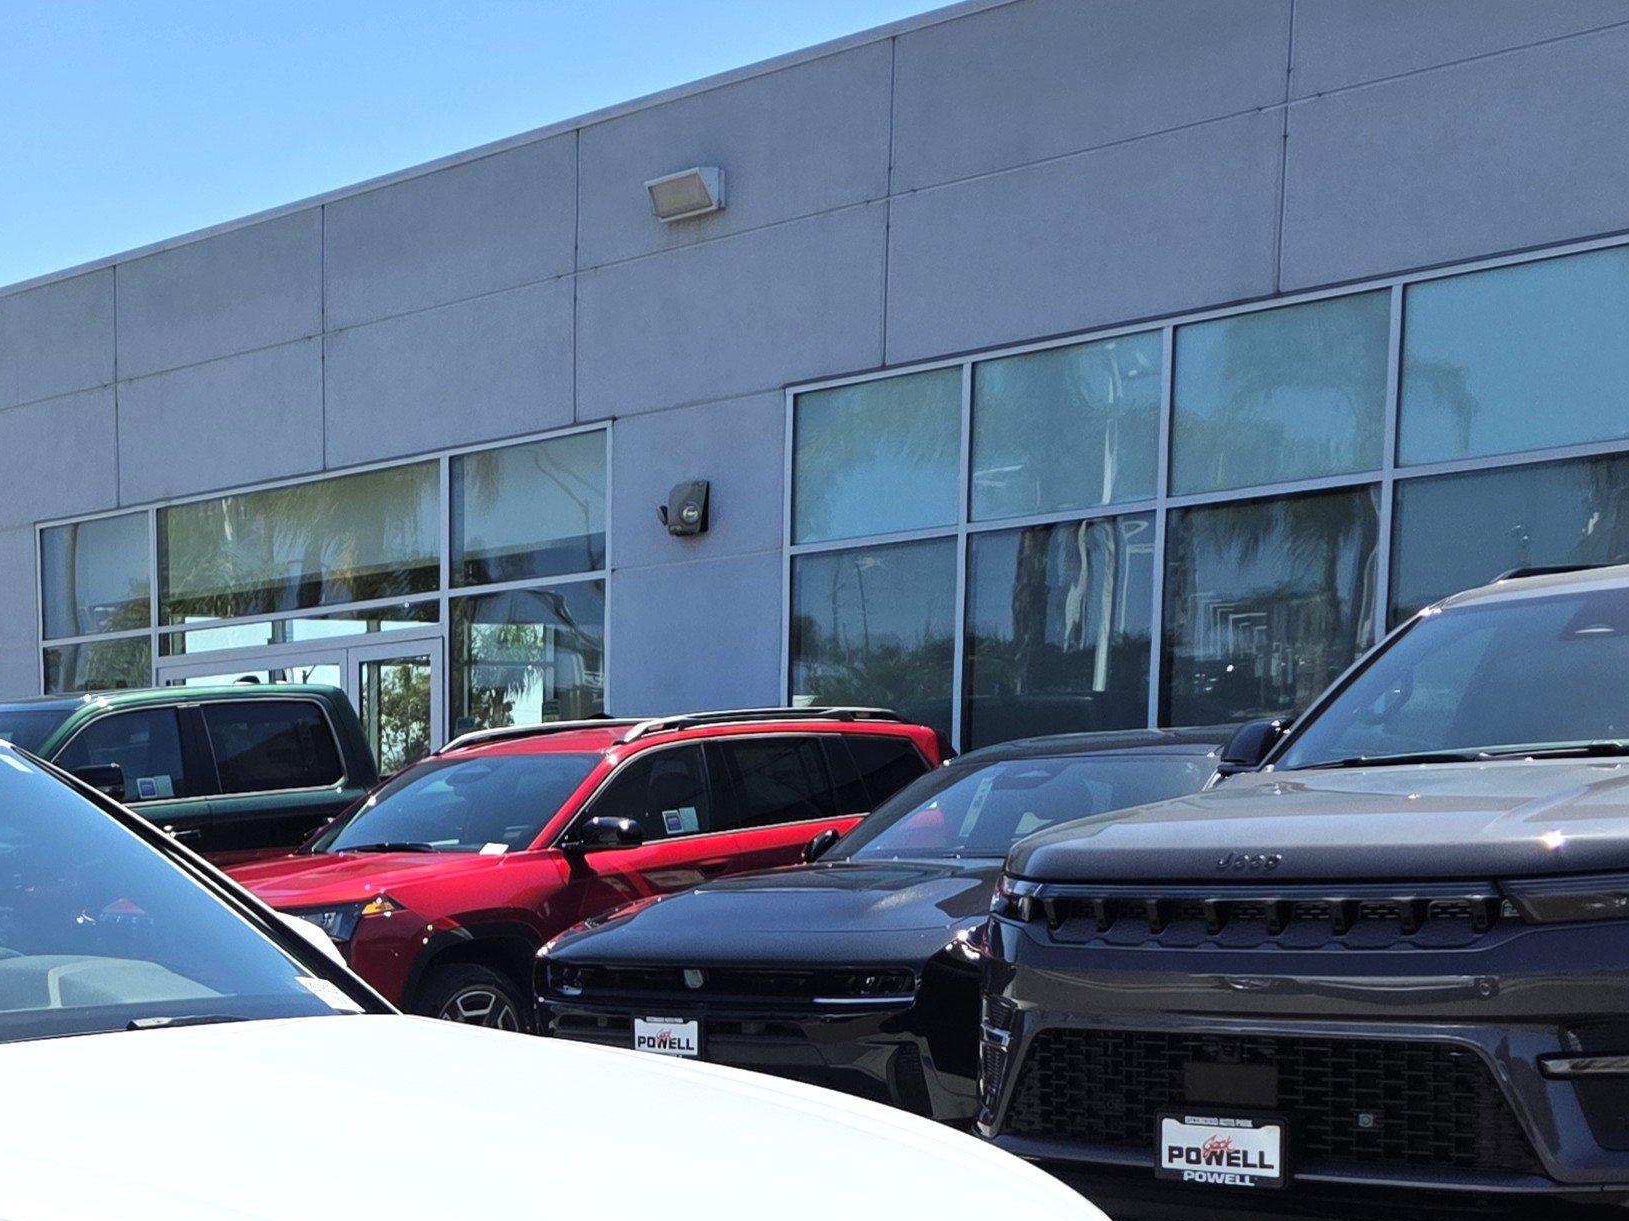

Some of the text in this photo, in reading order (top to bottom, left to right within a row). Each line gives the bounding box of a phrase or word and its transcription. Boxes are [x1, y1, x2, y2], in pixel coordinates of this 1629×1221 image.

[1216, 851, 1282, 869] Jeep
[638, 1035, 695, 1051] POWELL
[1168, 1145, 1274, 1169] POWELL
[1183, 1170, 1255, 1186] POWELL
